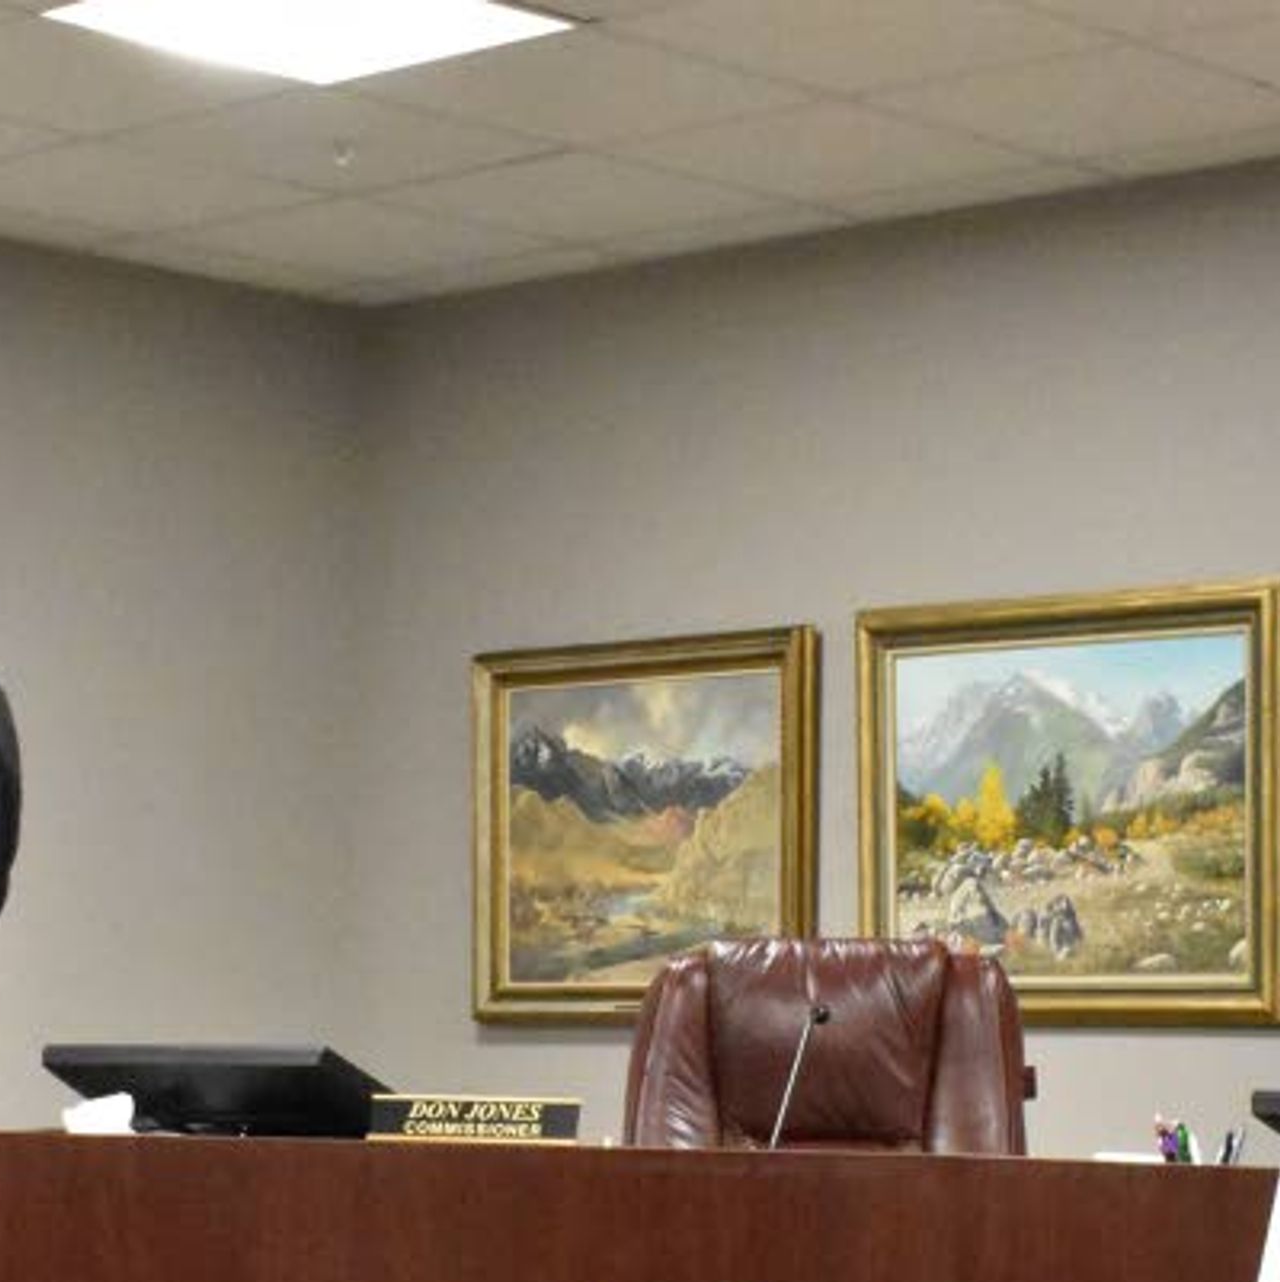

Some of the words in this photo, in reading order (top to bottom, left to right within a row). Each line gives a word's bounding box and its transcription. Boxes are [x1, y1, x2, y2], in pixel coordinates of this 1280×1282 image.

[408, 1101, 461, 1119] DON
[465, 1102, 543, 1121] JONES
[403, 1120, 542, 1137] COMMISSIONER
